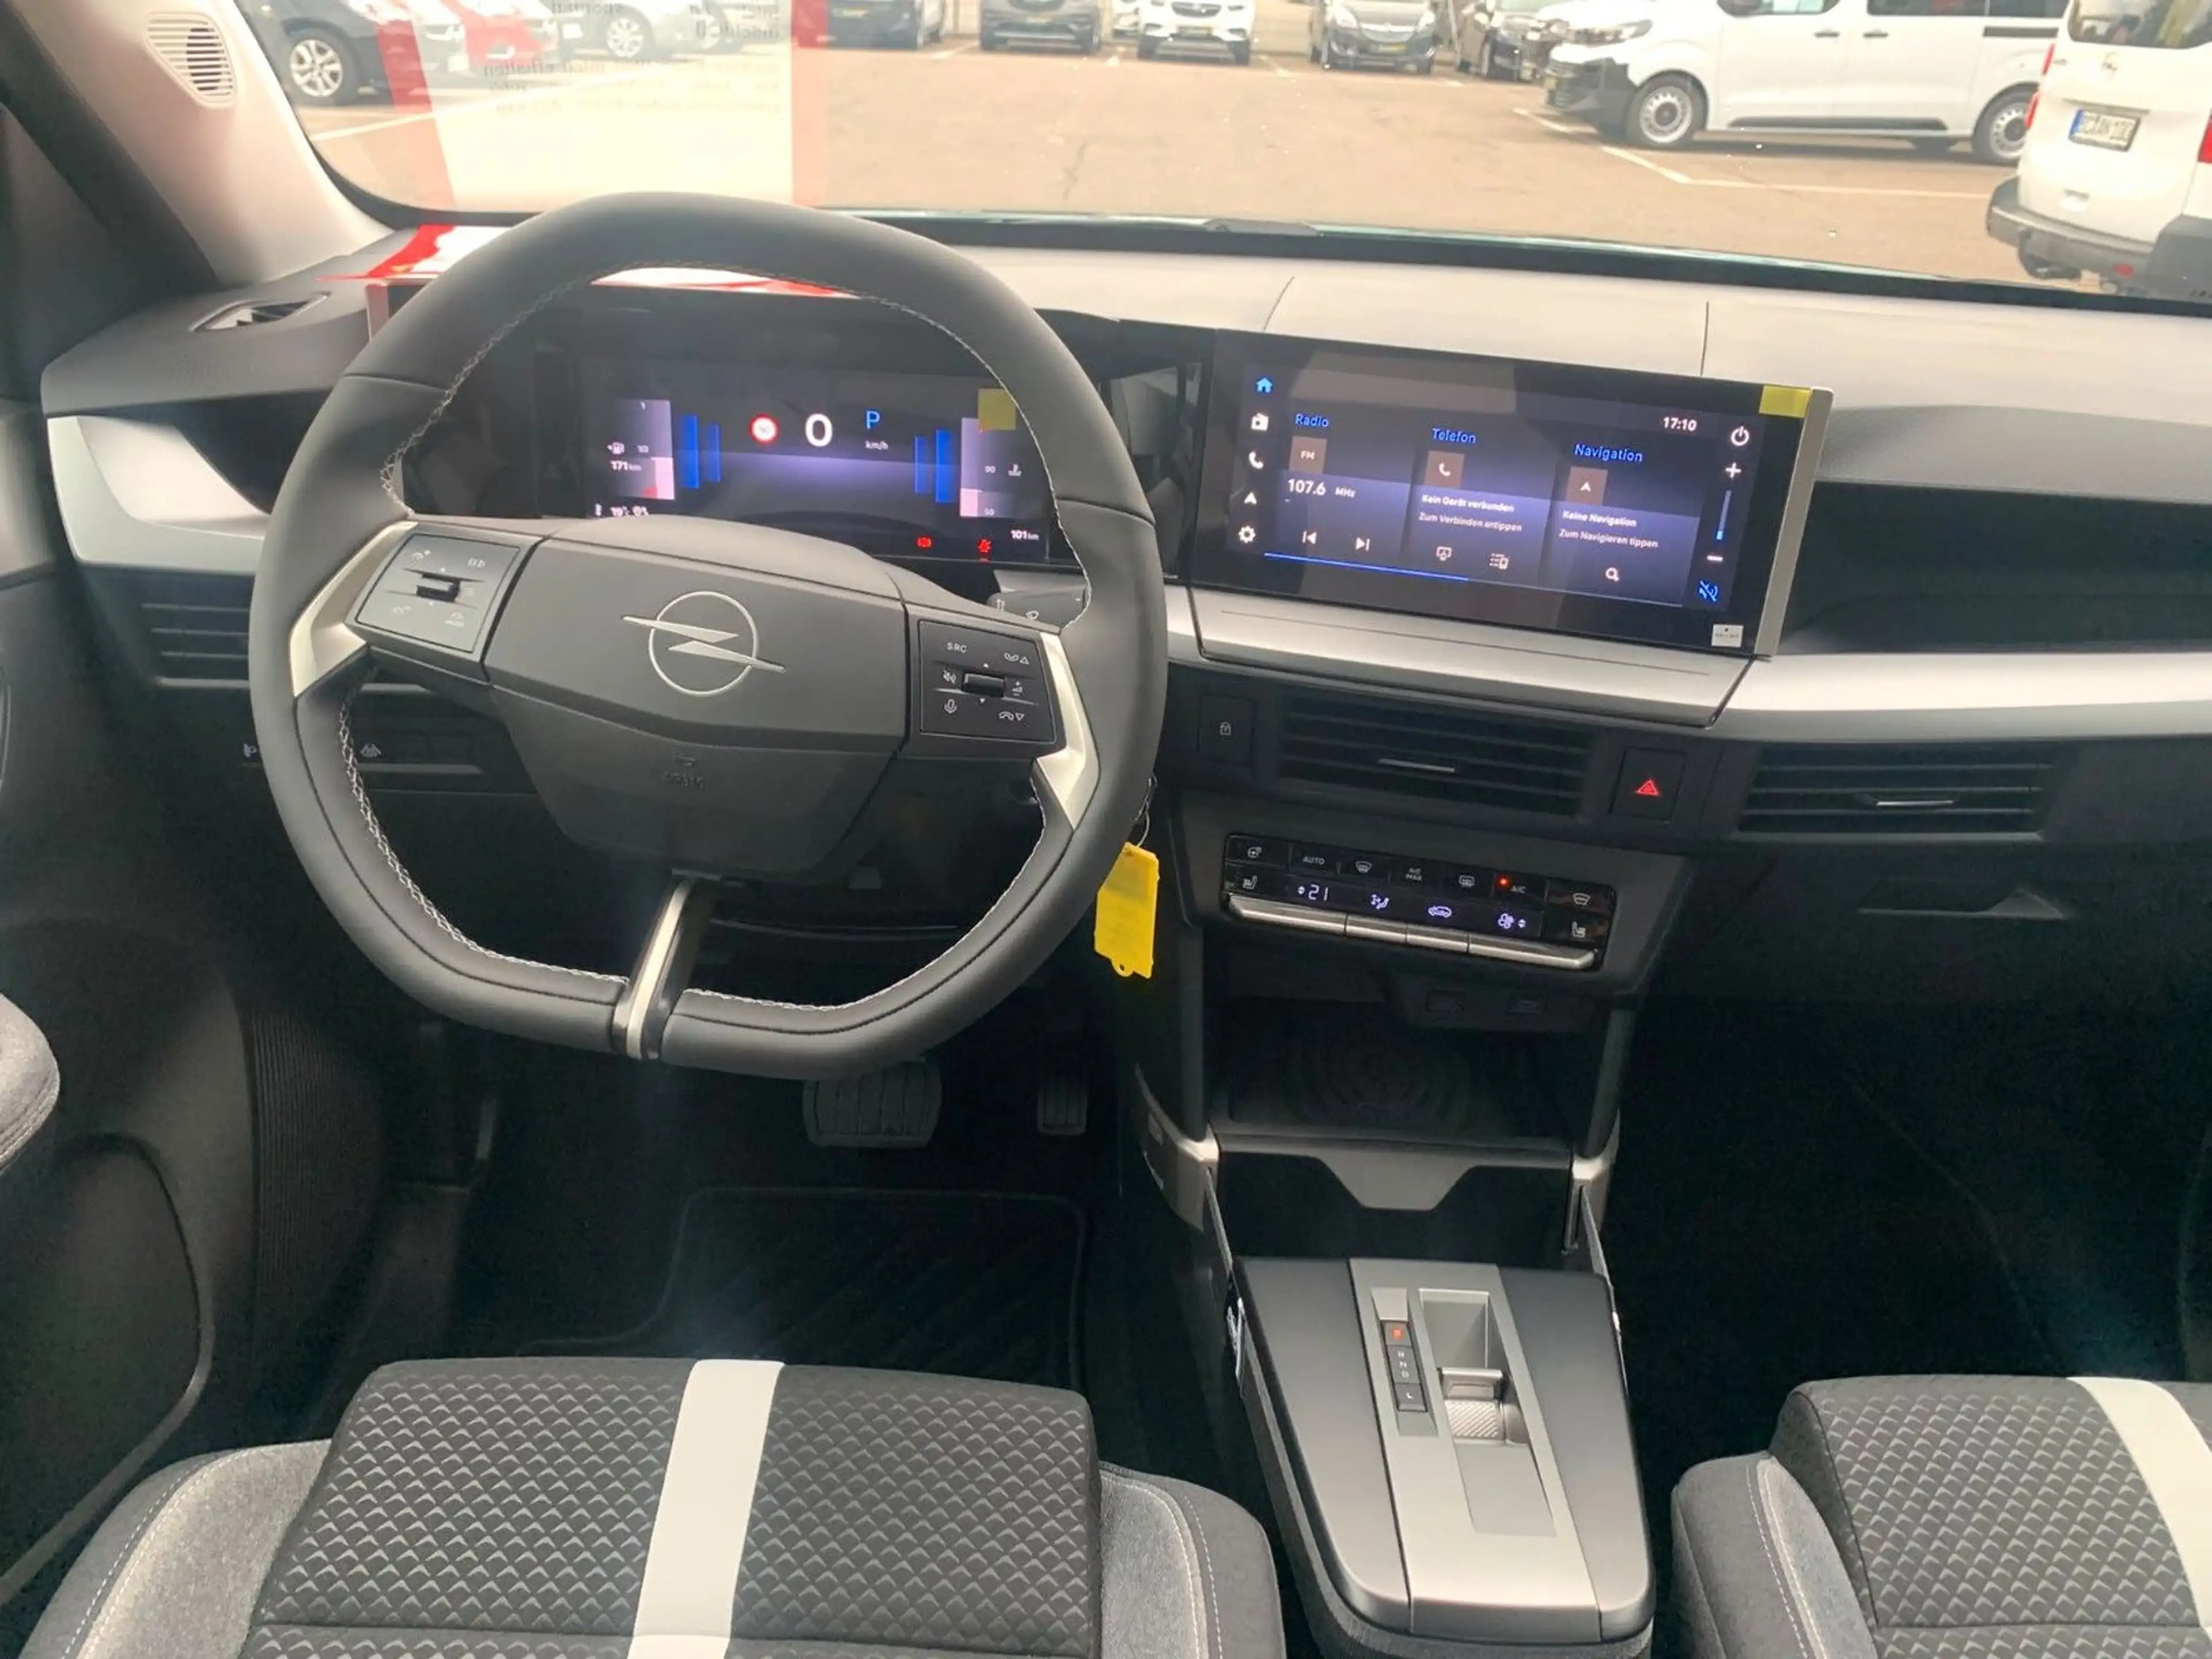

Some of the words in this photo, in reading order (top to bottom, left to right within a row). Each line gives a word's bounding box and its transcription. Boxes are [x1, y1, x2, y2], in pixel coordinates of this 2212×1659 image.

[865, 410, 881, 429] P
[1295, 413, 1329, 427] Radio
[1662, 416, 1697, 431] 17:10
[805, 413, 833, 448] 0
[1432, 428, 1476, 444] Telefon
[865, 441, 888, 450] km/h
[1574, 444, 1643, 463] Navigation
[1301, 450, 1316, 460] FM
[1288, 478, 1326, 495] 107.6
[1335, 487, 1356, 498] MHz
[1421, 494, 1441, 504] Kein
[1468, 500, 1514, 513] verbunden
[1418, 512, 1438, 521] Zum
[1439, 515, 1483, 527] Verbinden
[1484, 520, 1522, 532] antippen
[1562, 510, 1588, 521] Keine
[1589, 513, 1637, 528] Navigation
[1559, 528, 1579, 539] Zum
[1580, 531, 1628, 544] Navigieren
[1629, 535, 1659, 548] tippen
[946, 642, 968, 654] SRC
[1302, 856, 1325, 865] AUTO
[1308, 884, 1329, 901] 21
